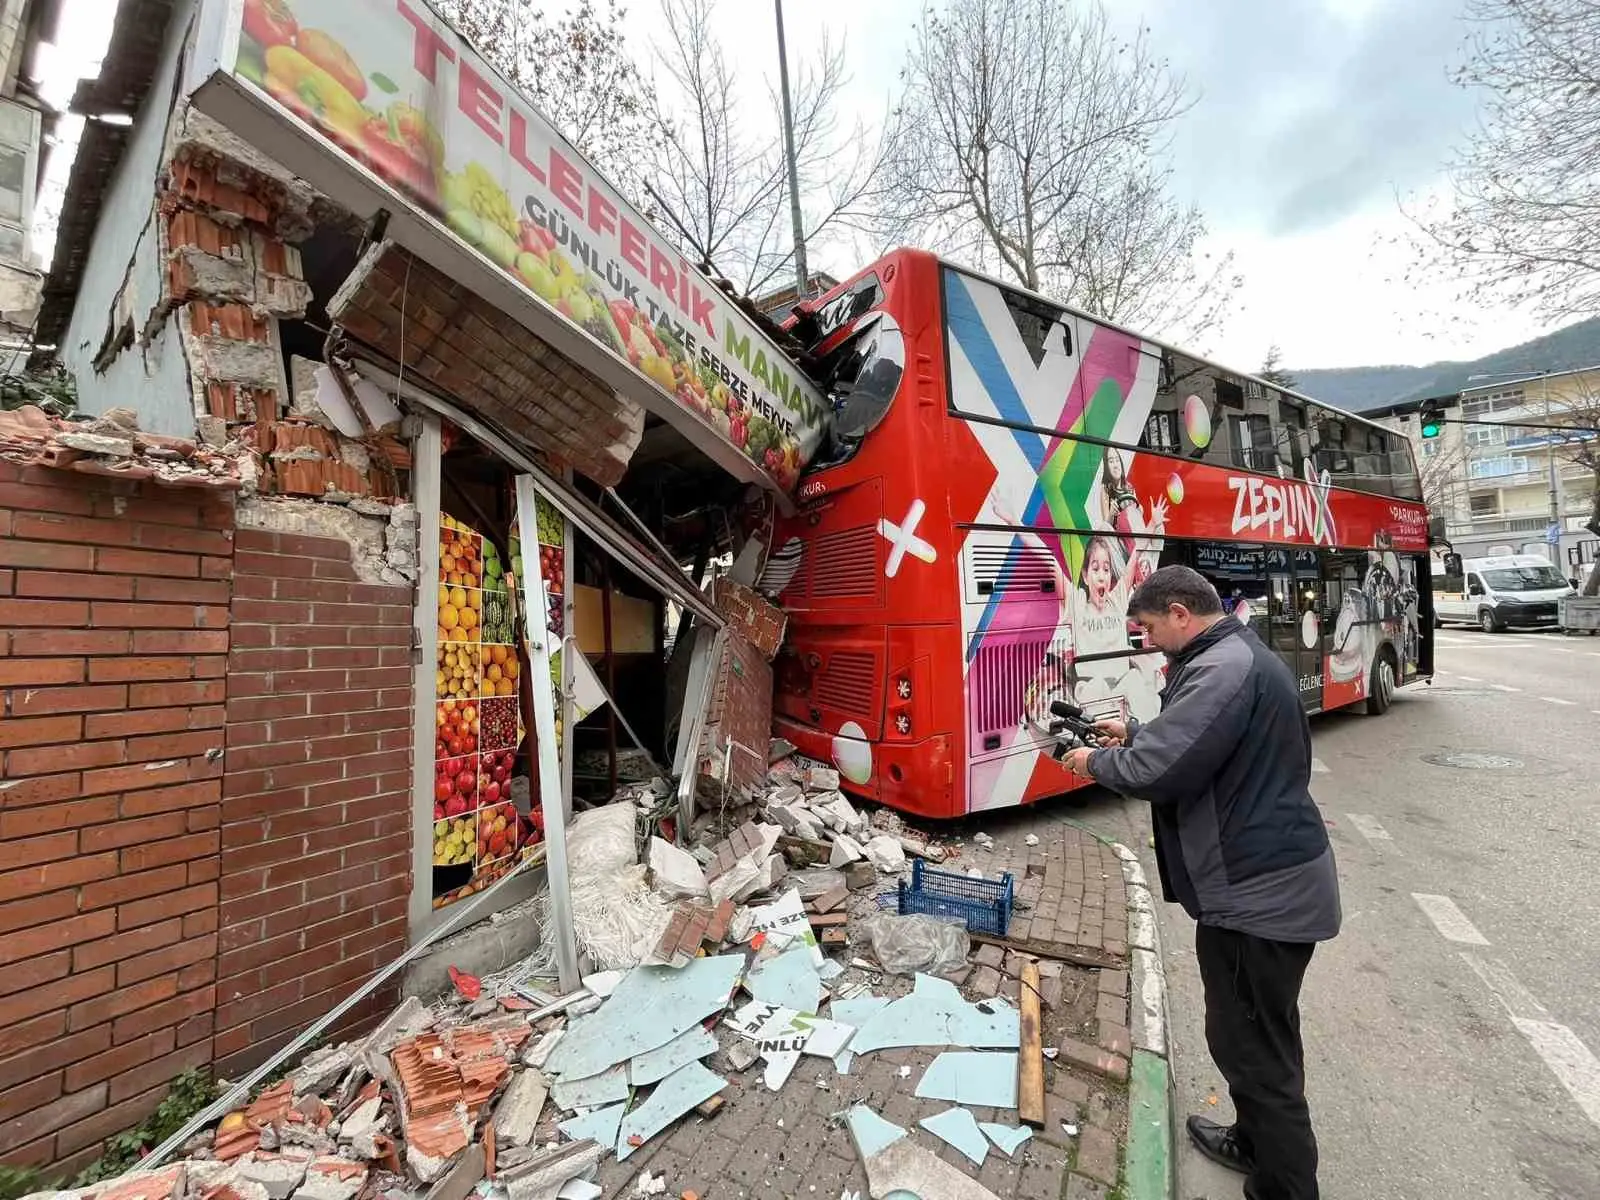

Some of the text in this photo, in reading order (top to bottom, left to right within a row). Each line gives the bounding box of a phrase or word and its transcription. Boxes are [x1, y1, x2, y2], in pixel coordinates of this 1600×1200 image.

[396, 0, 716, 341] TELEFERİK
[525, 195, 793, 437] GÜNLÜK TAZE SEBZE MEYVE
